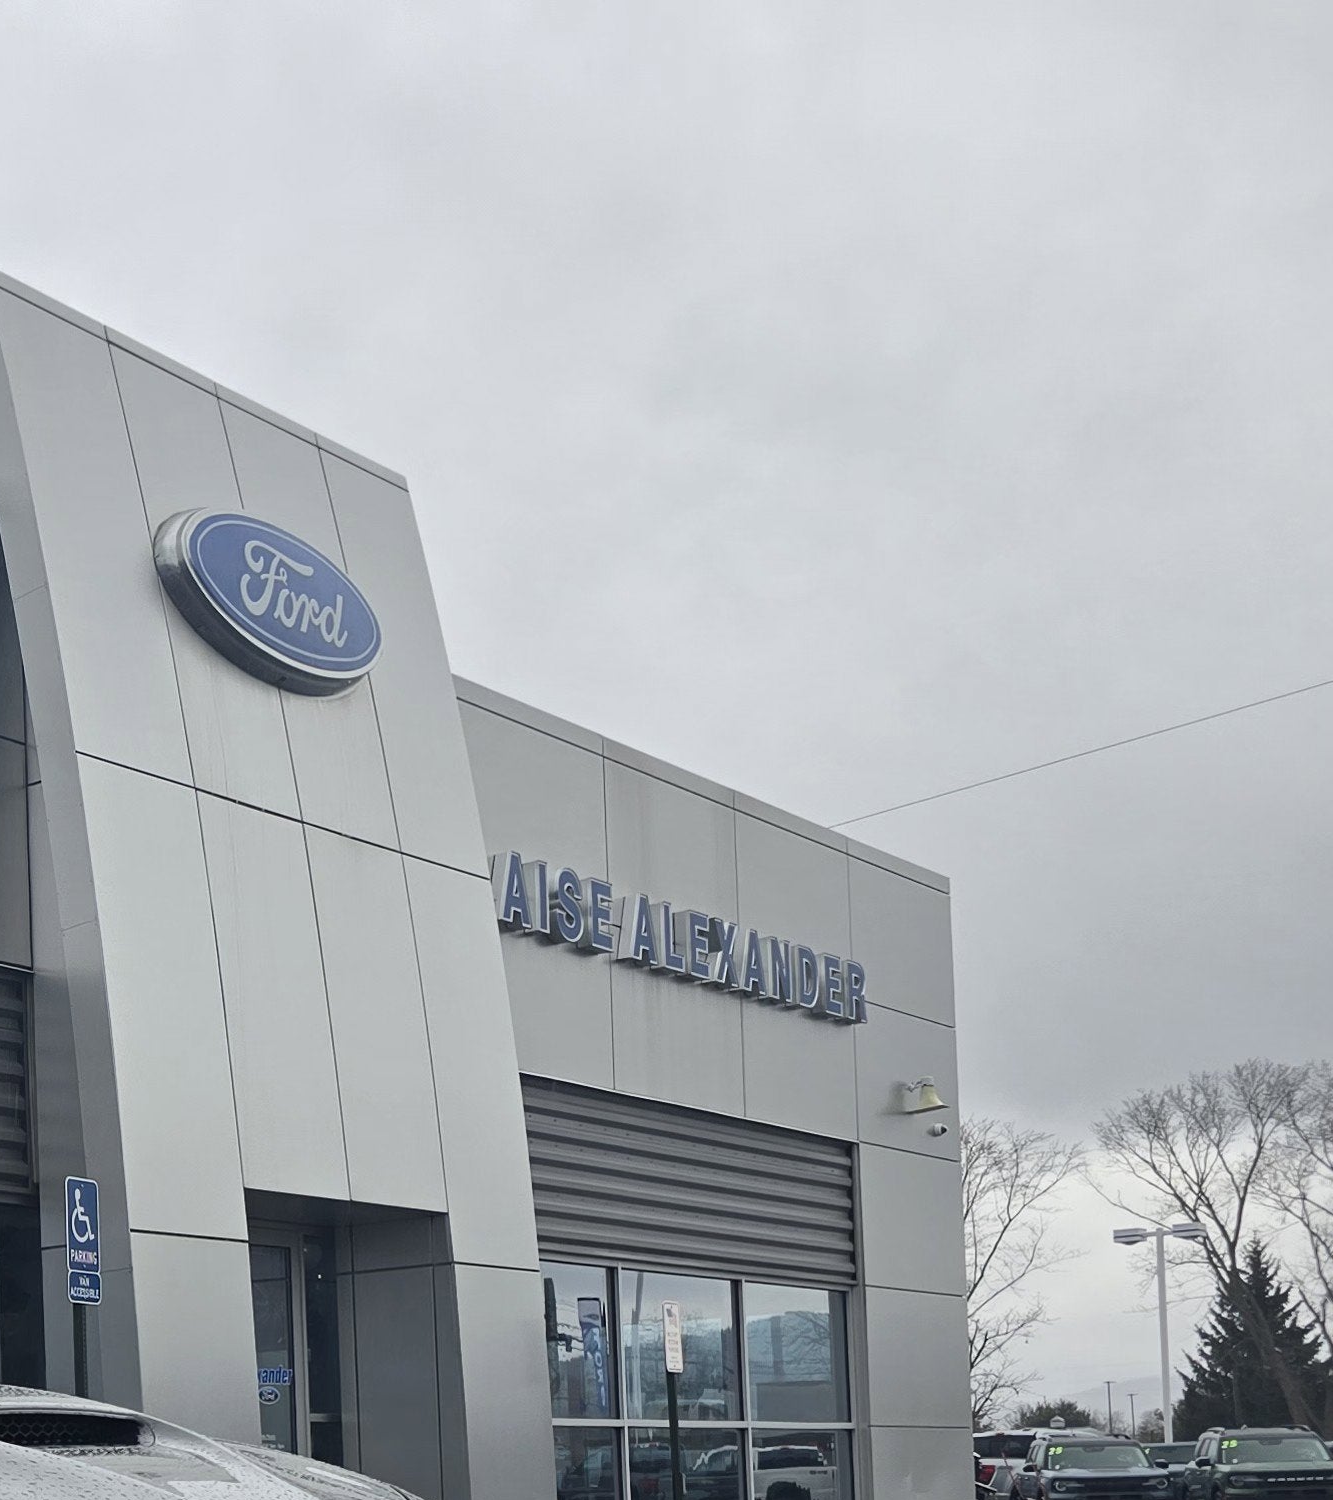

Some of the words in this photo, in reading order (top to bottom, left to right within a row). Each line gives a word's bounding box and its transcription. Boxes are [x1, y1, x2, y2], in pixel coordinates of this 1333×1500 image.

[240, 540, 348, 648] Ford
[632, 892, 868, 1024] ALEXANDER
[71, 1249, 97, 1265] PARKING
[79, 1276, 90, 1287] VAN
[71, 1288, 99, 1299] ACCESSIBLE
